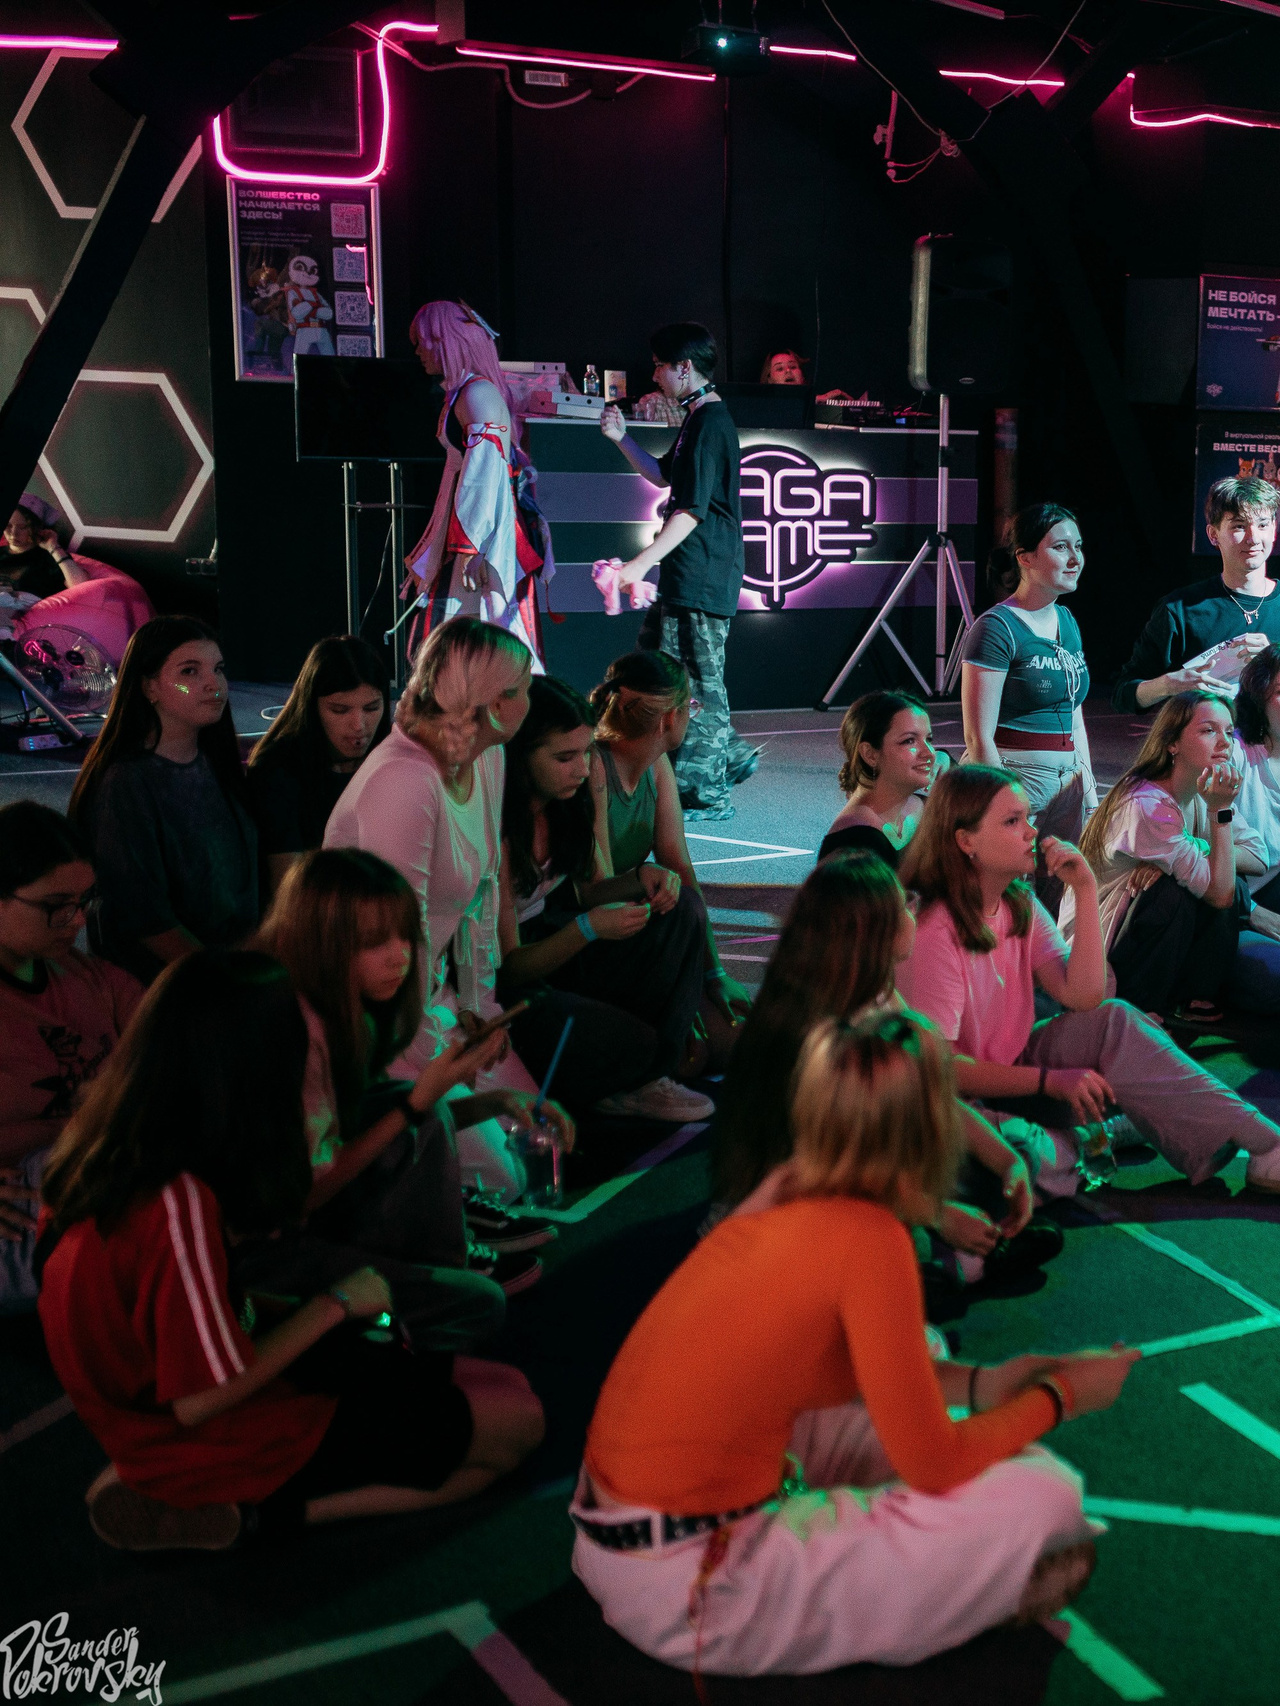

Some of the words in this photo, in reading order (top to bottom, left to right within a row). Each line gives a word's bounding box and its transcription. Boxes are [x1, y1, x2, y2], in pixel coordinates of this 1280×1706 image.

[238, 189, 320, 201] ВОЛШЕБСТВО
[239, 200, 320, 211] НАЧИНАЕТСЯ
[240, 210, 283, 220] ЗДЕСЬ!
[1208, 289, 1228, 301] НЕ
[1229, 291, 1276, 305] БОЙСЯ
[1207, 306, 1275, 321] МЕЧТАТЬ
[1212, 442, 1257, 452] ВМЕСТЕ
[740, 468, 871, 517] AGA
[741, 520, 872, 603] AME
